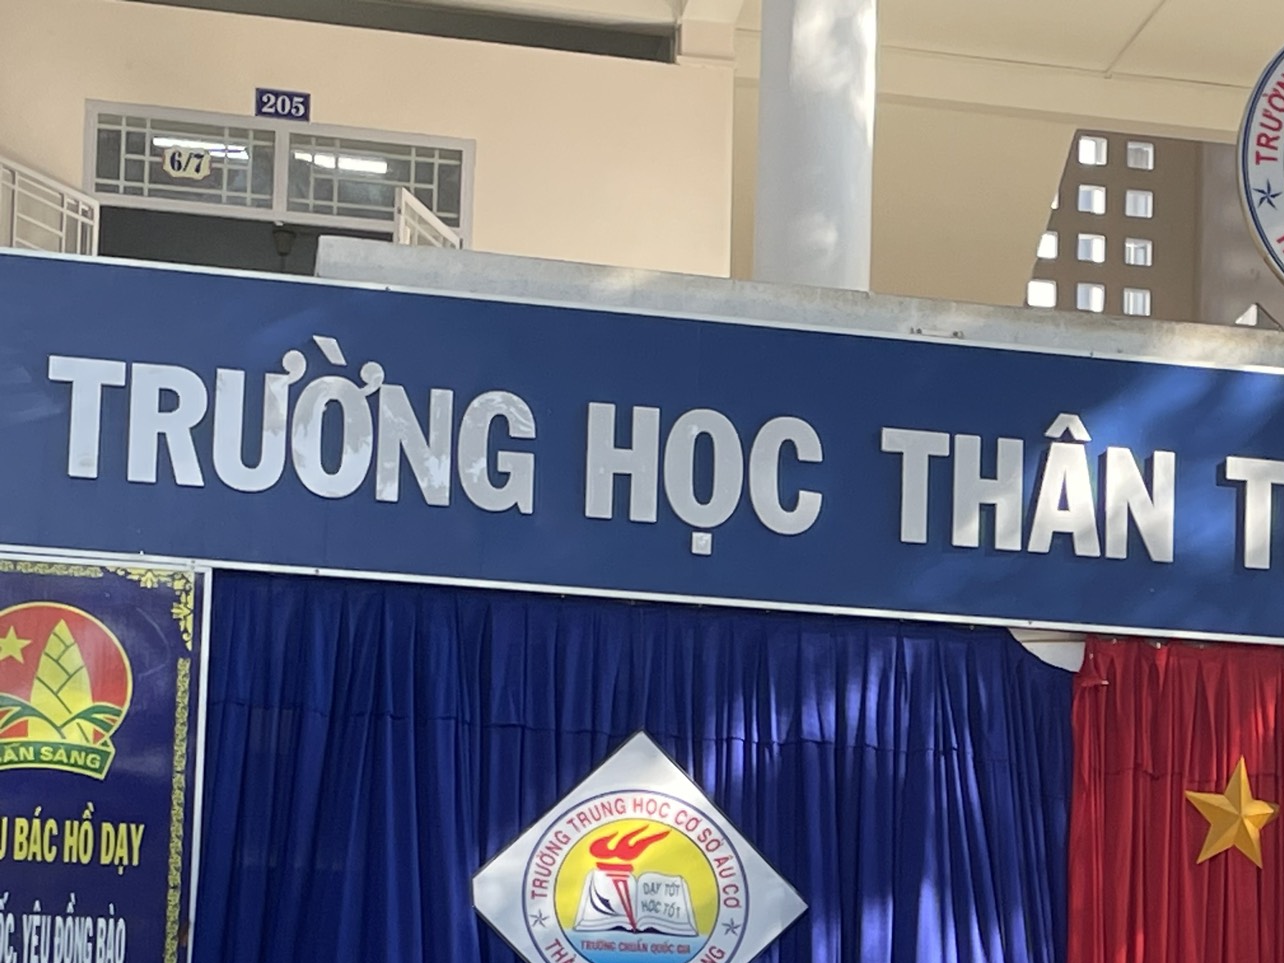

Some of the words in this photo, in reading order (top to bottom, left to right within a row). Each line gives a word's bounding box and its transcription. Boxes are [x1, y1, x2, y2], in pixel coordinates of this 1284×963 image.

[261, 93, 306, 118] 205
[168, 150, 206, 175] 6/7
[48, 334, 537, 516] TRƯỜNG
[584, 402, 824, 556] HỌC
[880, 412, 1175, 564] THÂN
[40, 744, 102, 769] SÀNG
[566, 797, 627, 833] TRUNG
[632, 797, 671, 819] HỌC
[674, 809, 703, 832] CƠ
[13, 805, 59, 863] BÁC
[63, 801, 95, 865] HỒ
[99, 821, 145, 876] DẠY
[697, 827, 726, 853] SỞ
[530, 829, 570, 901] TRƯỜNG
[713, 854, 736, 879] ÂU
[722, 883, 742, 909] CƠ
